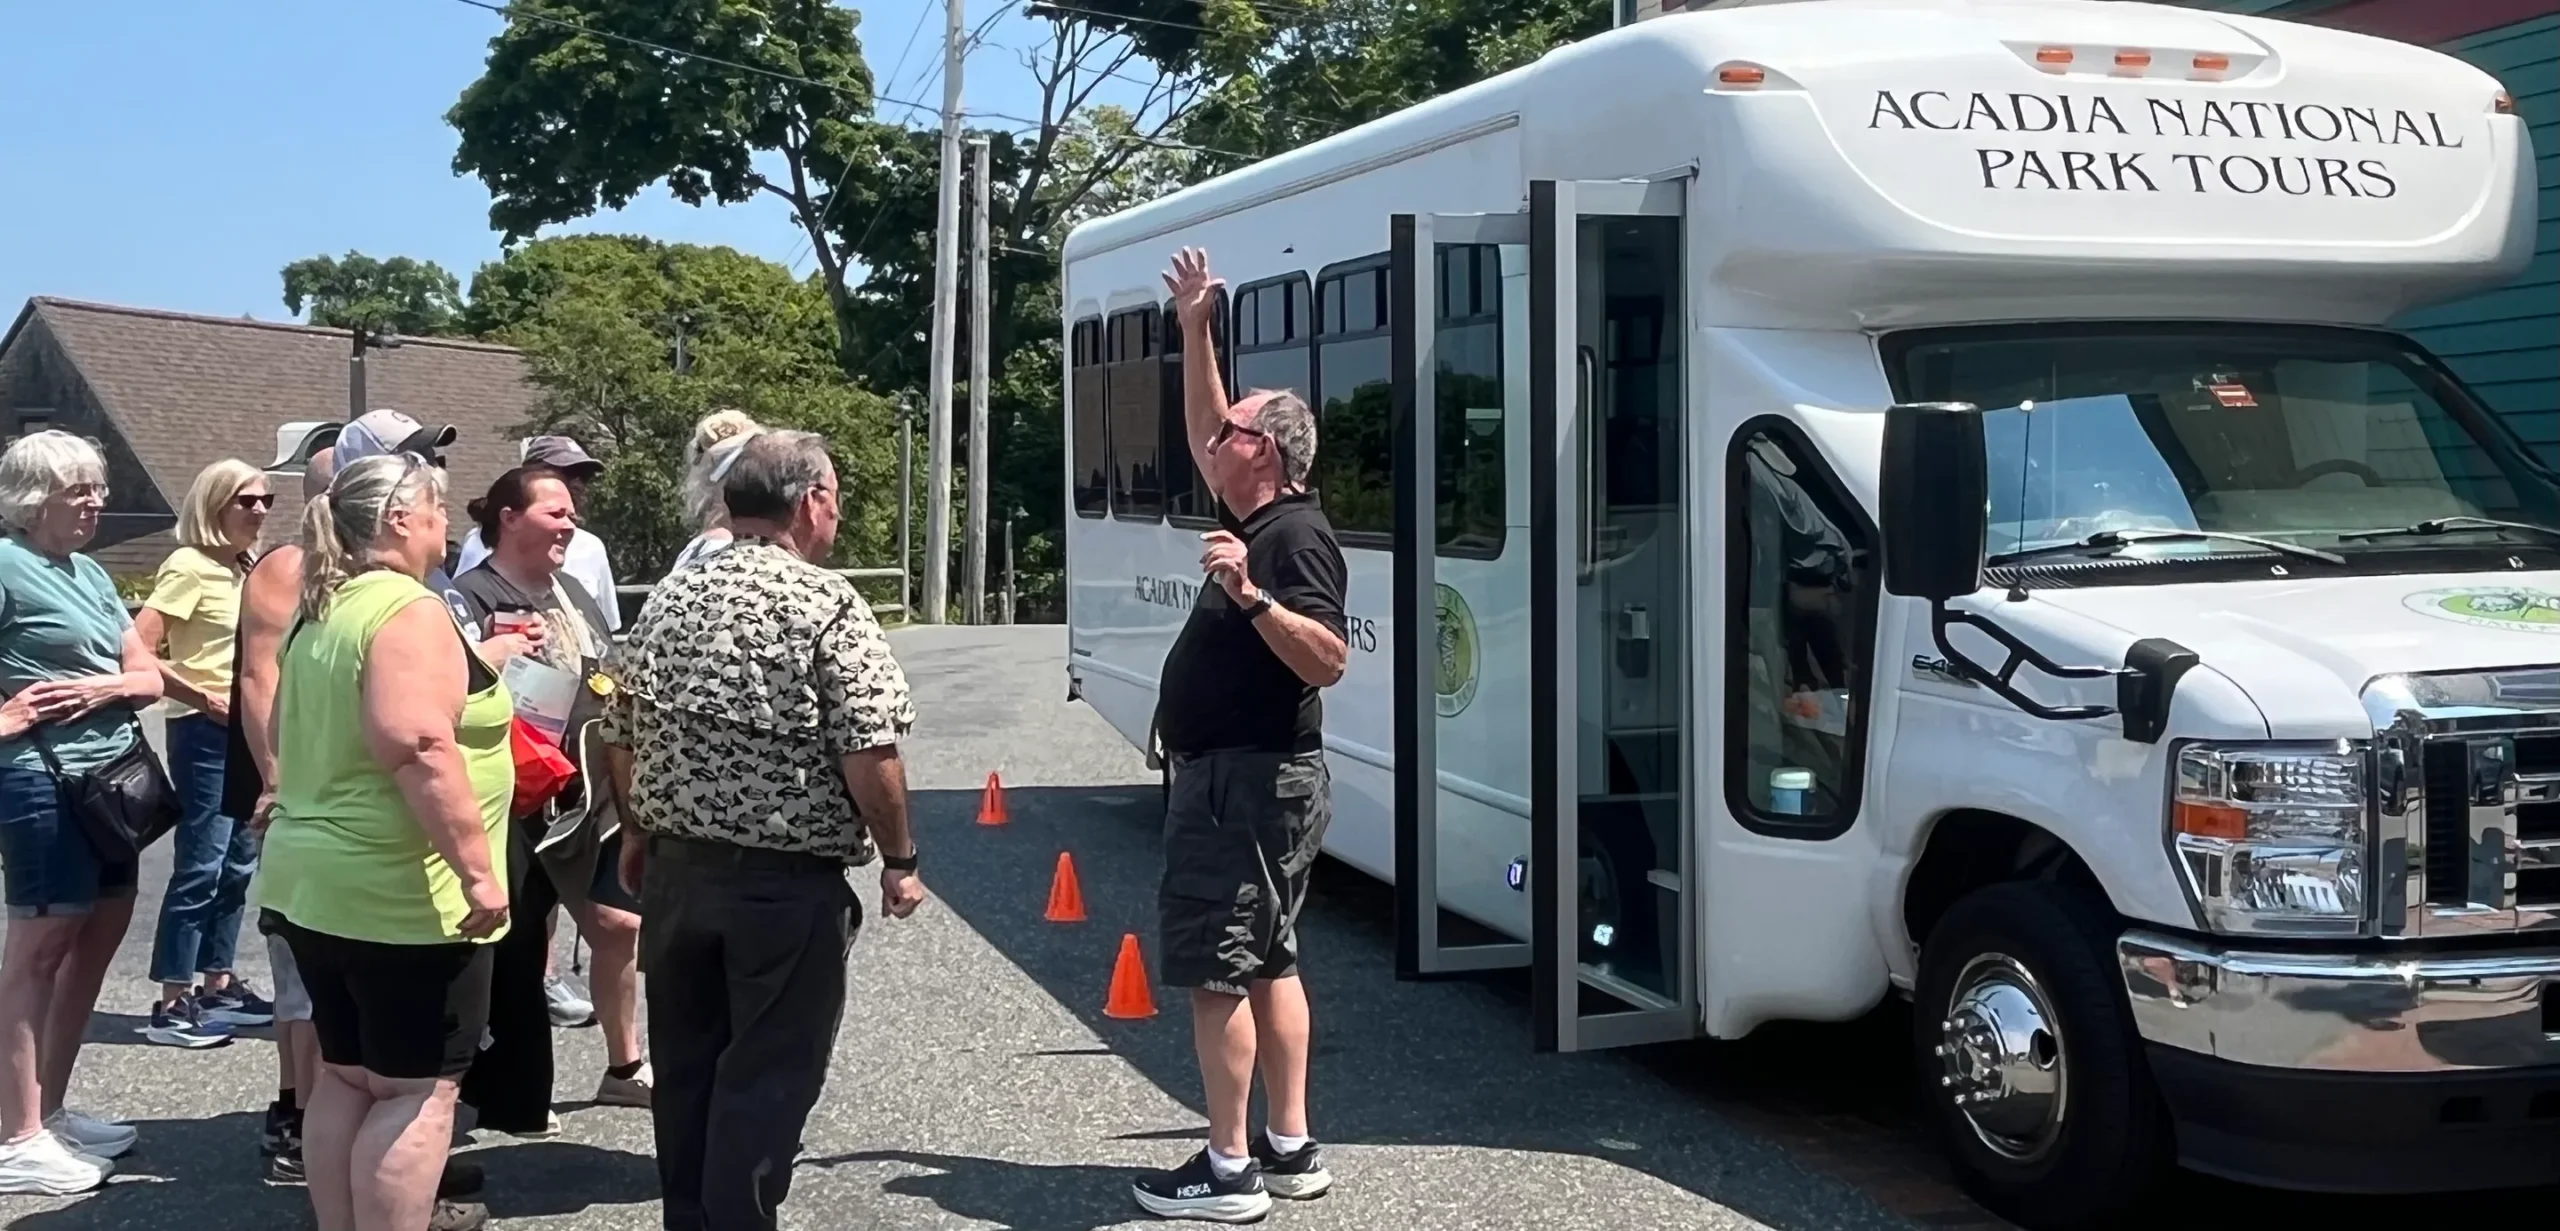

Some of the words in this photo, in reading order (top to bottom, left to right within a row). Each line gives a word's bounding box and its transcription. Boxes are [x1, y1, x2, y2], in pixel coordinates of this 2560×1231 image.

[1868, 90, 2129, 134] ACADIA
[2145, 98, 2464, 149] NATIONAL
[1976, 149, 2161, 192] PARK
[2172, 154, 2397, 198] TOURS
[1135, 575, 1179, 609] ACADIA
[1177, 1183, 1211, 1198] HOKA
